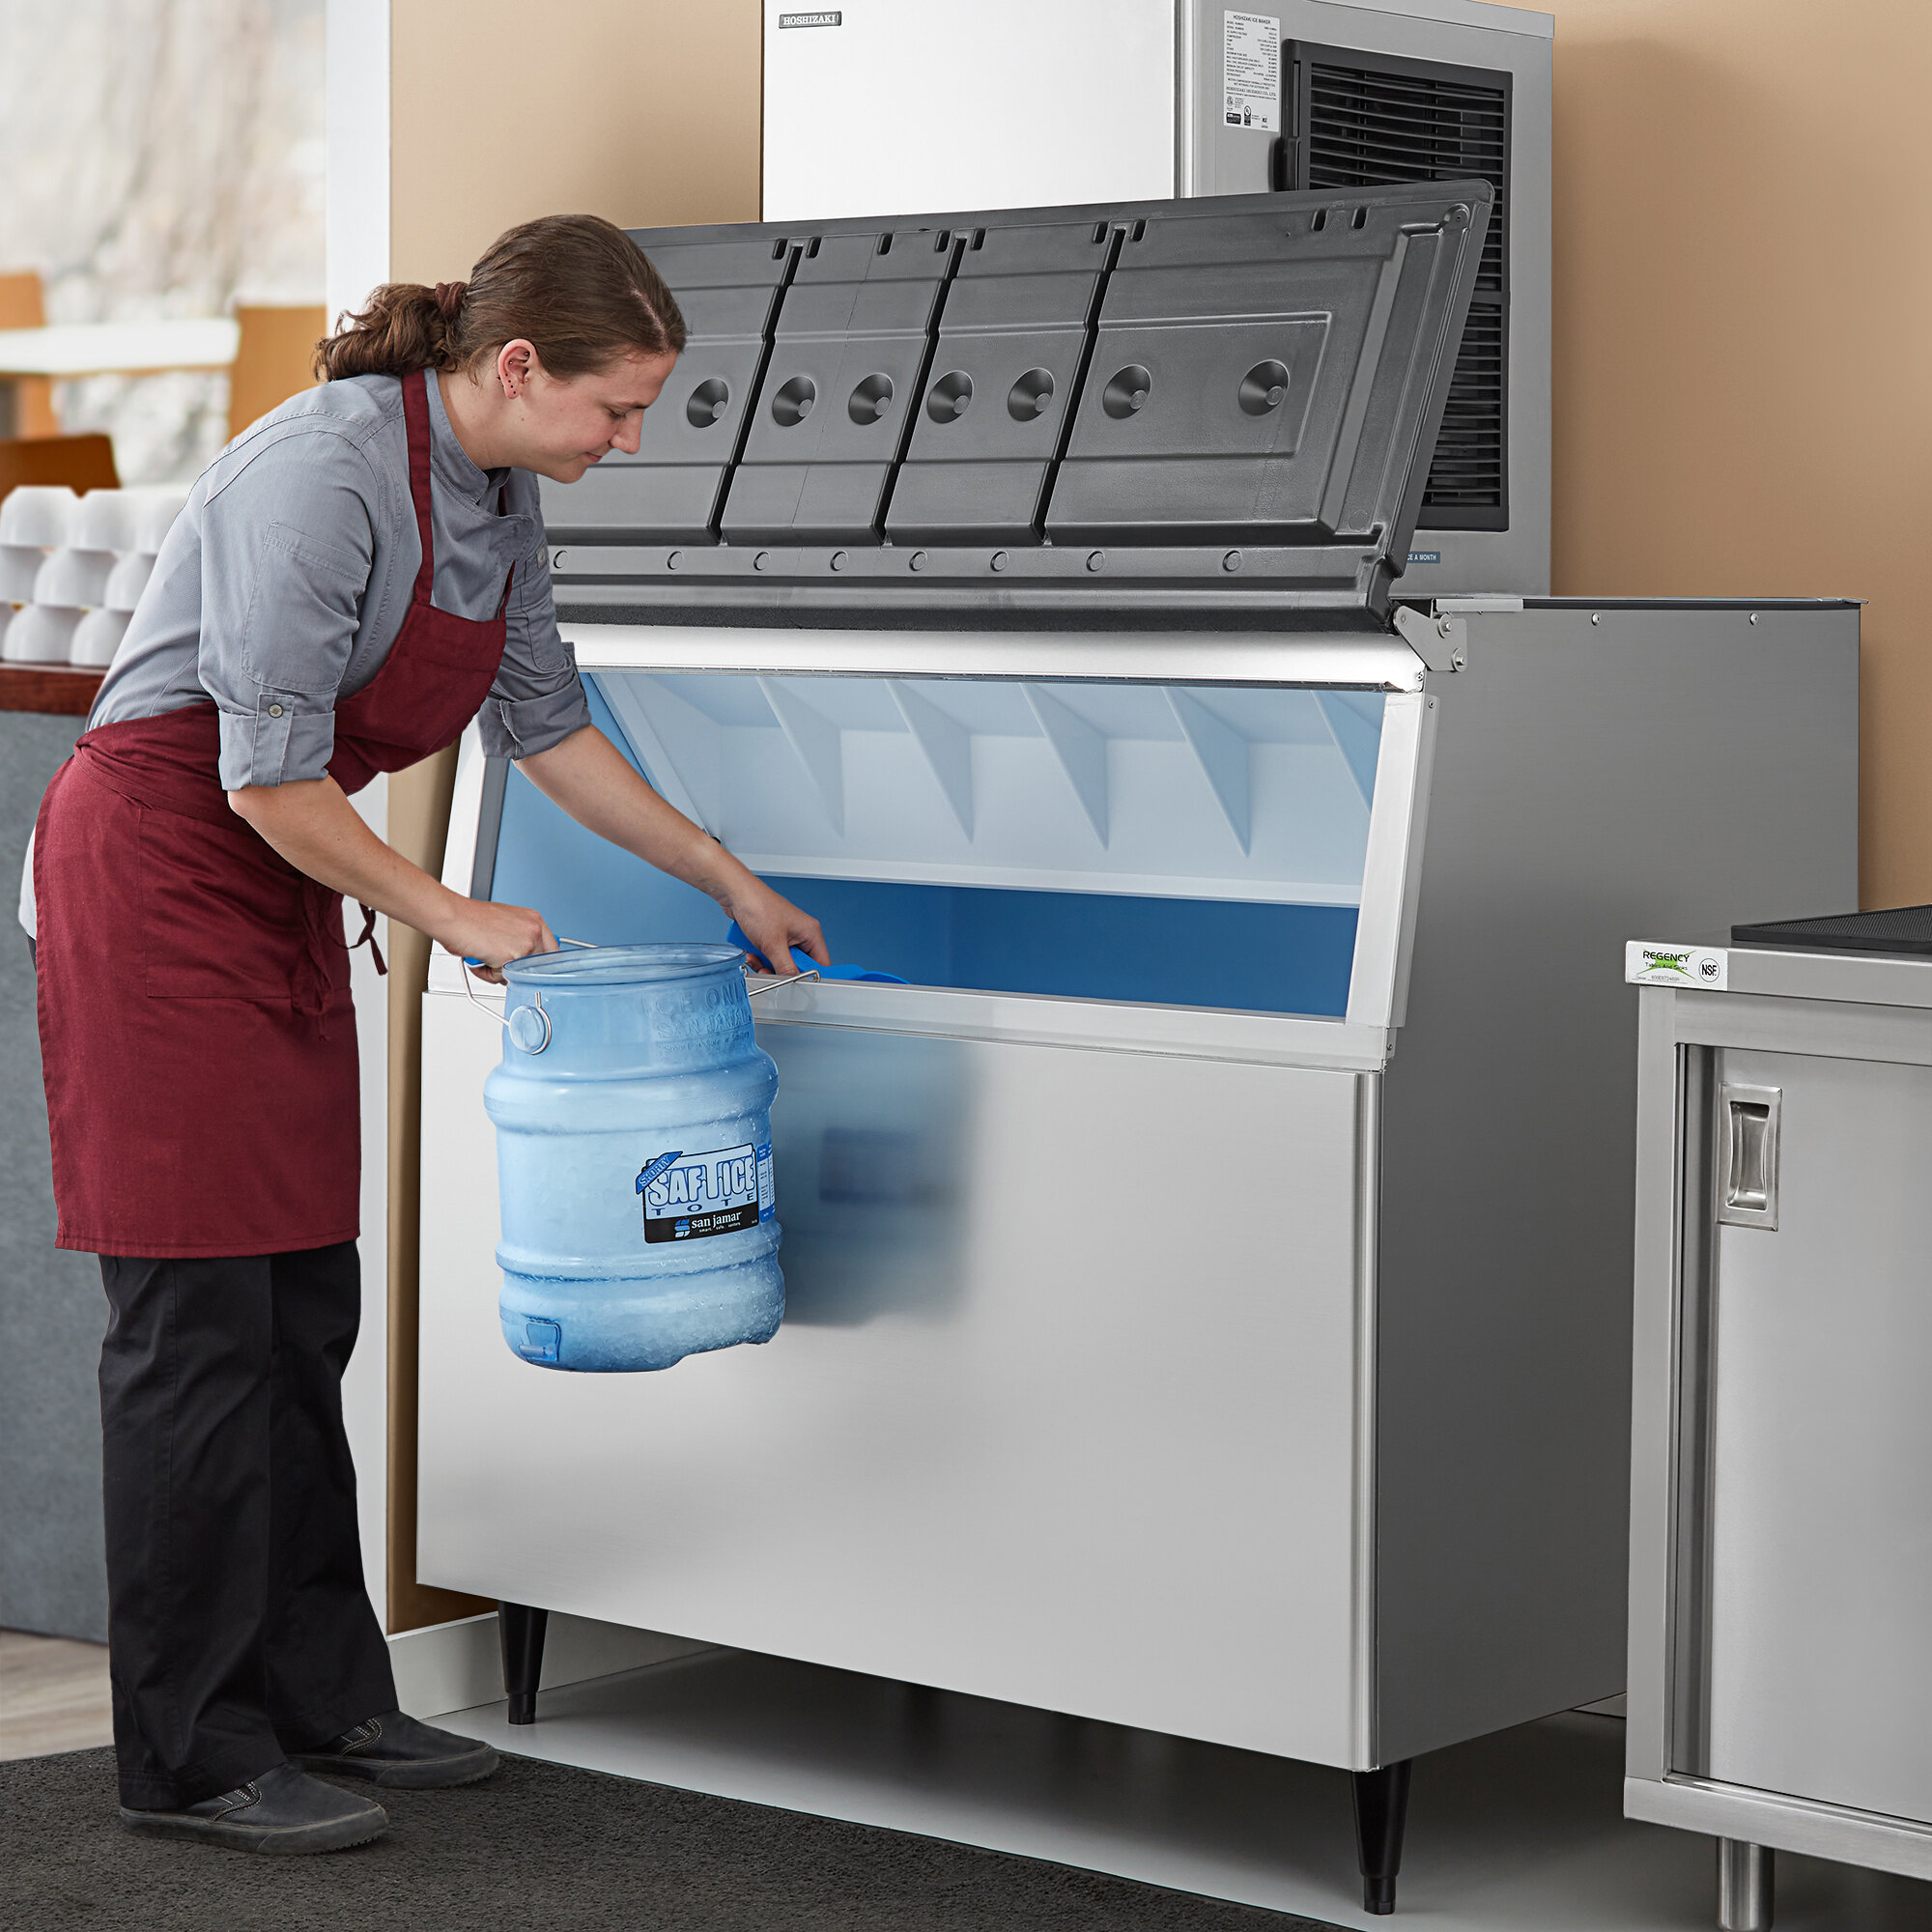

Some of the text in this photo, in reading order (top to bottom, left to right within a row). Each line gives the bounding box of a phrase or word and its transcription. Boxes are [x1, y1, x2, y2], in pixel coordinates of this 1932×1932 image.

[783, 14, 836, 25] HOSHIZAKI
[1642, 951, 1690, 963] REGENCY
[705, 978, 748, 1009] ONLY
[639, 1154, 669, 1187] SHORTY
[691, 1211, 742, 1229] san jamar
